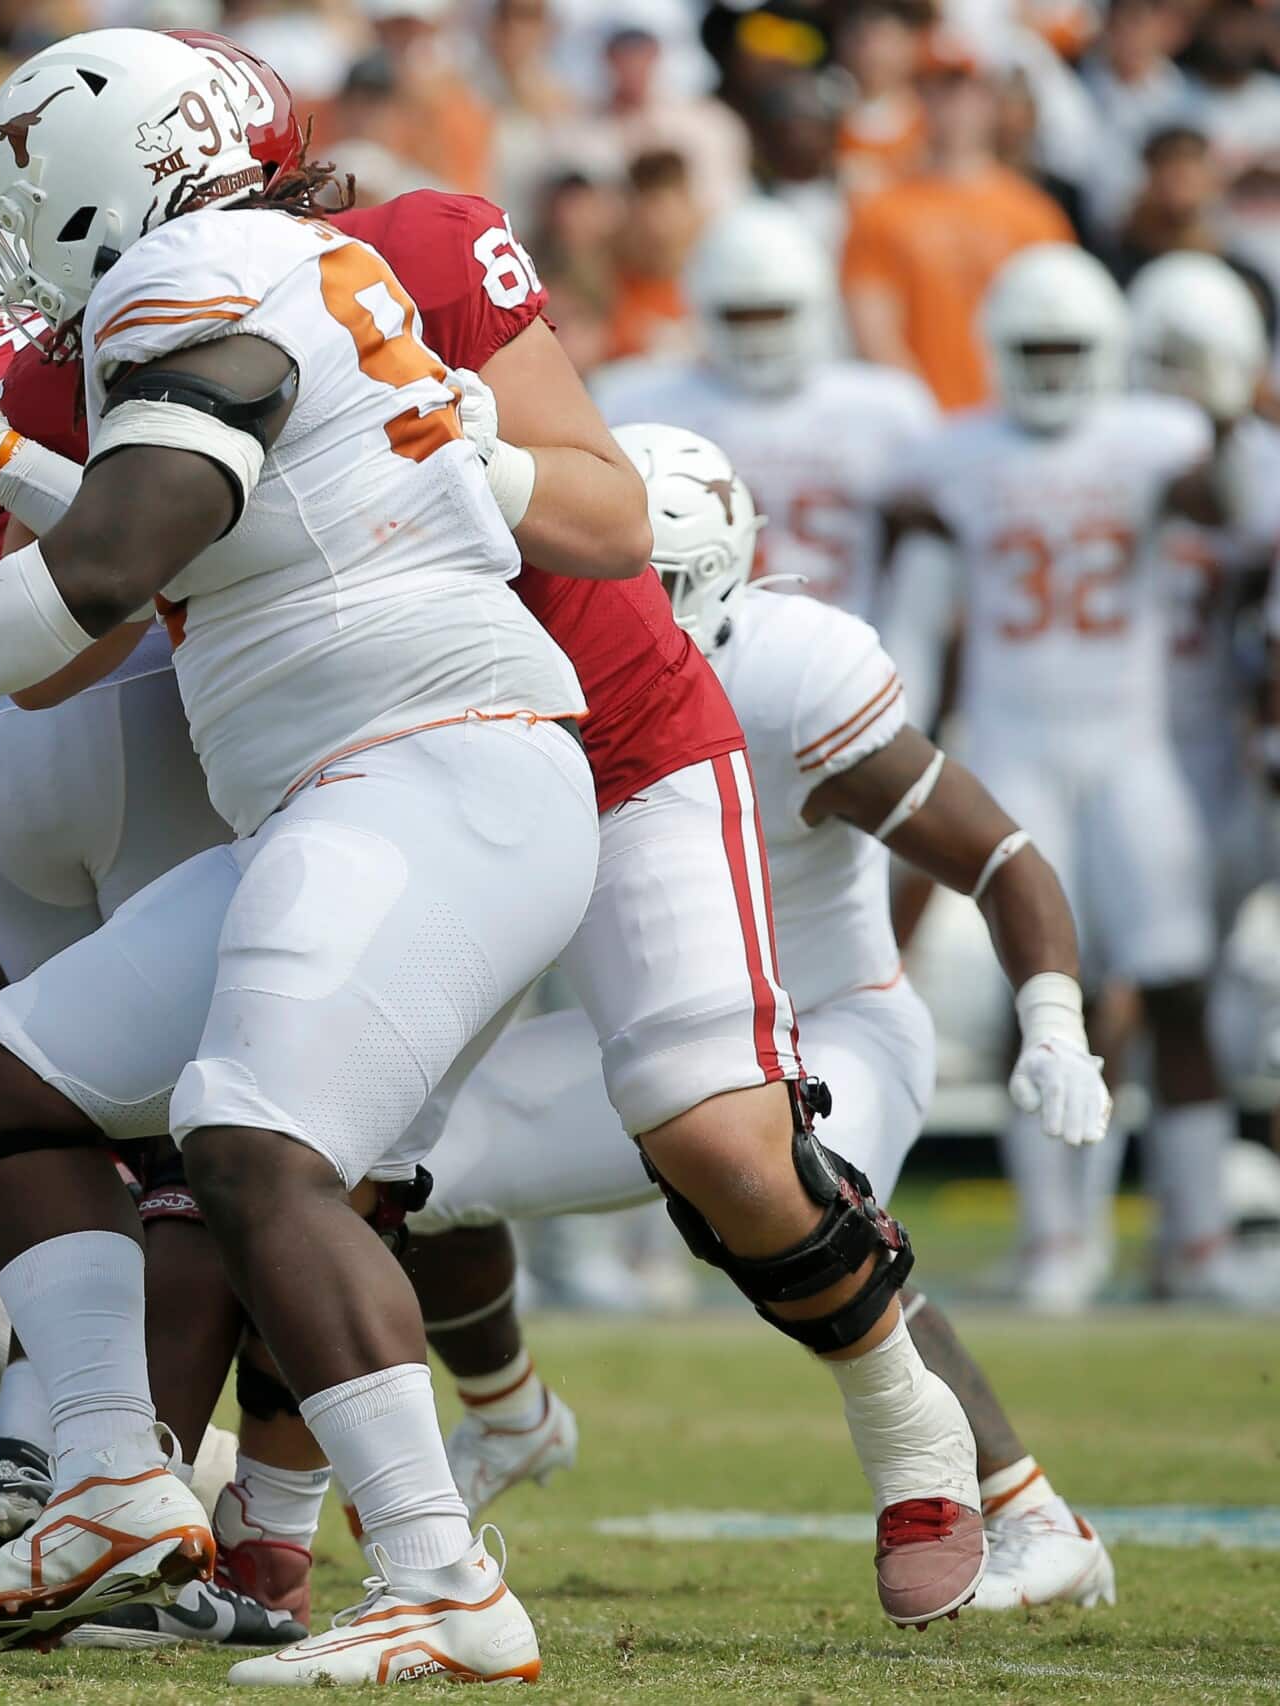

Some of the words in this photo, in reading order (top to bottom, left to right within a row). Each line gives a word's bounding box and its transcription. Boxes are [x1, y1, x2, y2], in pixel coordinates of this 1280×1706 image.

[179, 79, 242, 156] 93
[144, 147, 191, 185] XII
[994, 516, 1134, 646] 32
[397, 1660, 448, 1682] ALPHA
